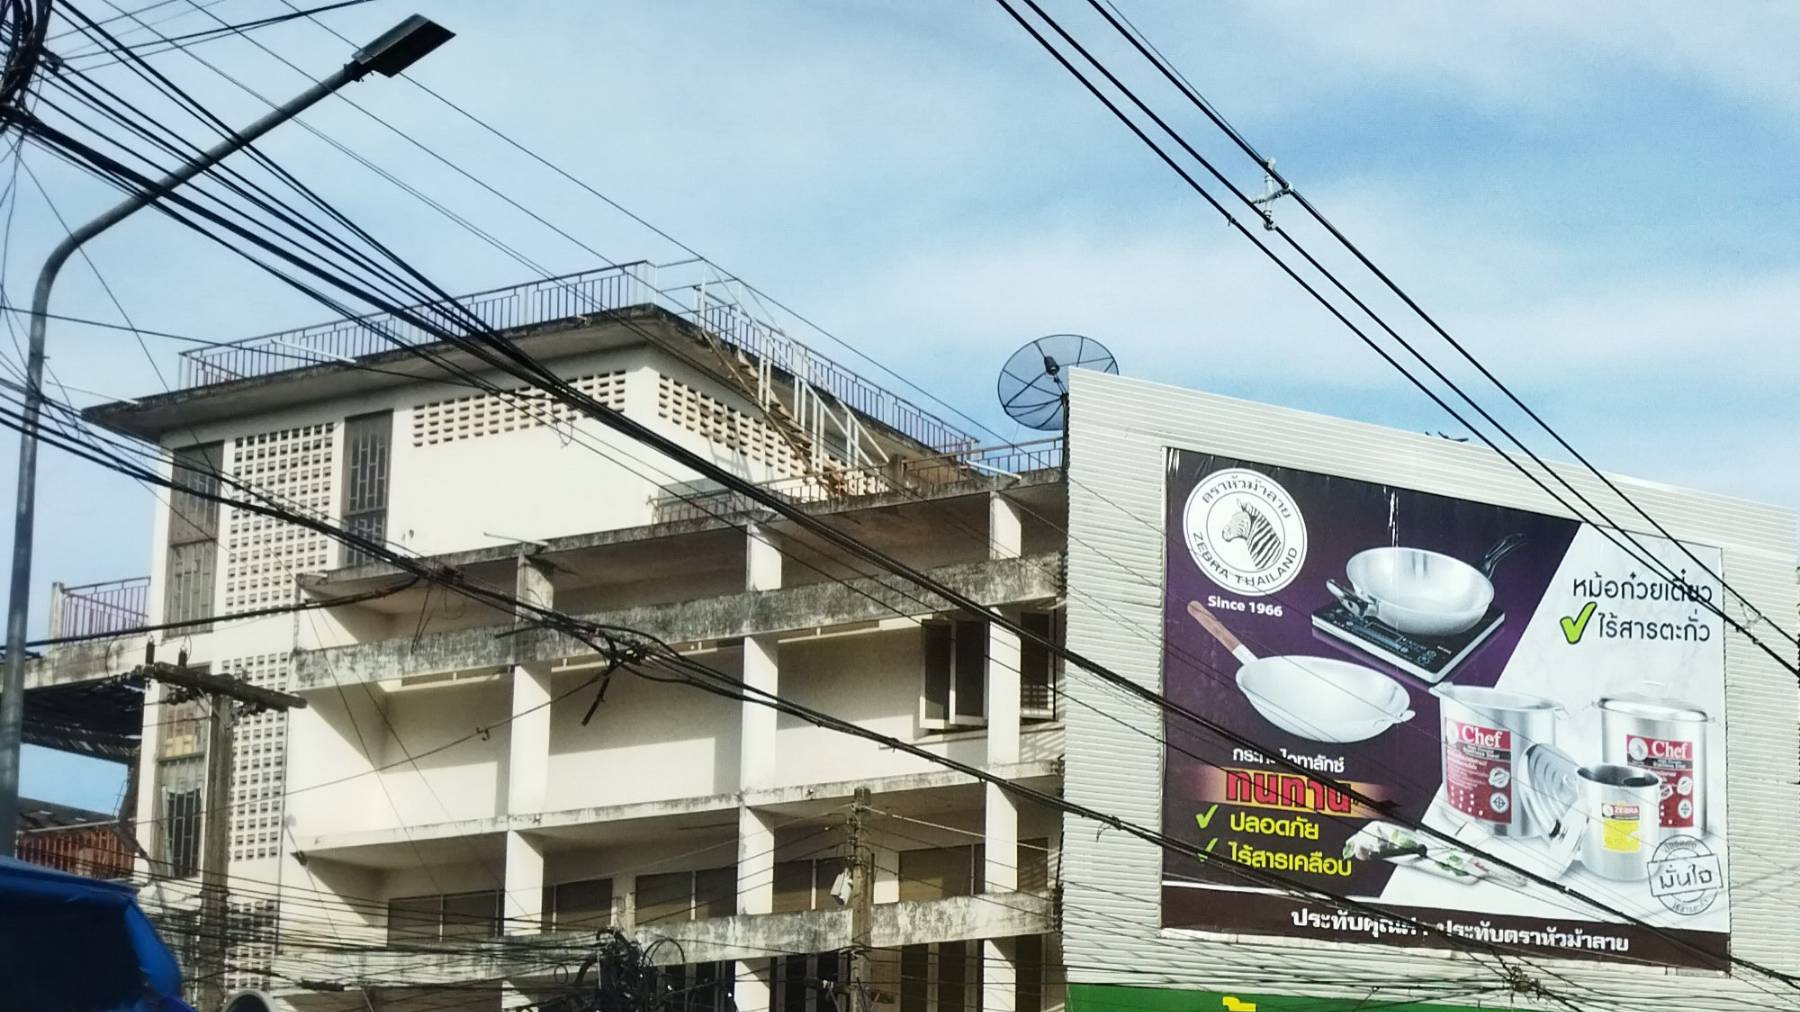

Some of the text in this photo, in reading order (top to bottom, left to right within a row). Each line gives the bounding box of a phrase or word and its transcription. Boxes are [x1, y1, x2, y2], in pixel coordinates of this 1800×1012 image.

[1193, 532, 1298, 587] ZEBRA THAILAND
[1208, 595, 1283, 617] Since 1966
[1598, 609, 1711, 642] ไร้สารตะกั่ว
[1461, 725, 1503, 748] Chef
[1652, 740, 1688, 759] Chef
[1226, 770, 1351, 813] ทนทาน
[1230, 811, 1319, 840] ปลอดภัย
[1228, 841, 1352, 876] ไร้สารเคลือบ
[1659, 864, 1713, 889] มั่นใจ
